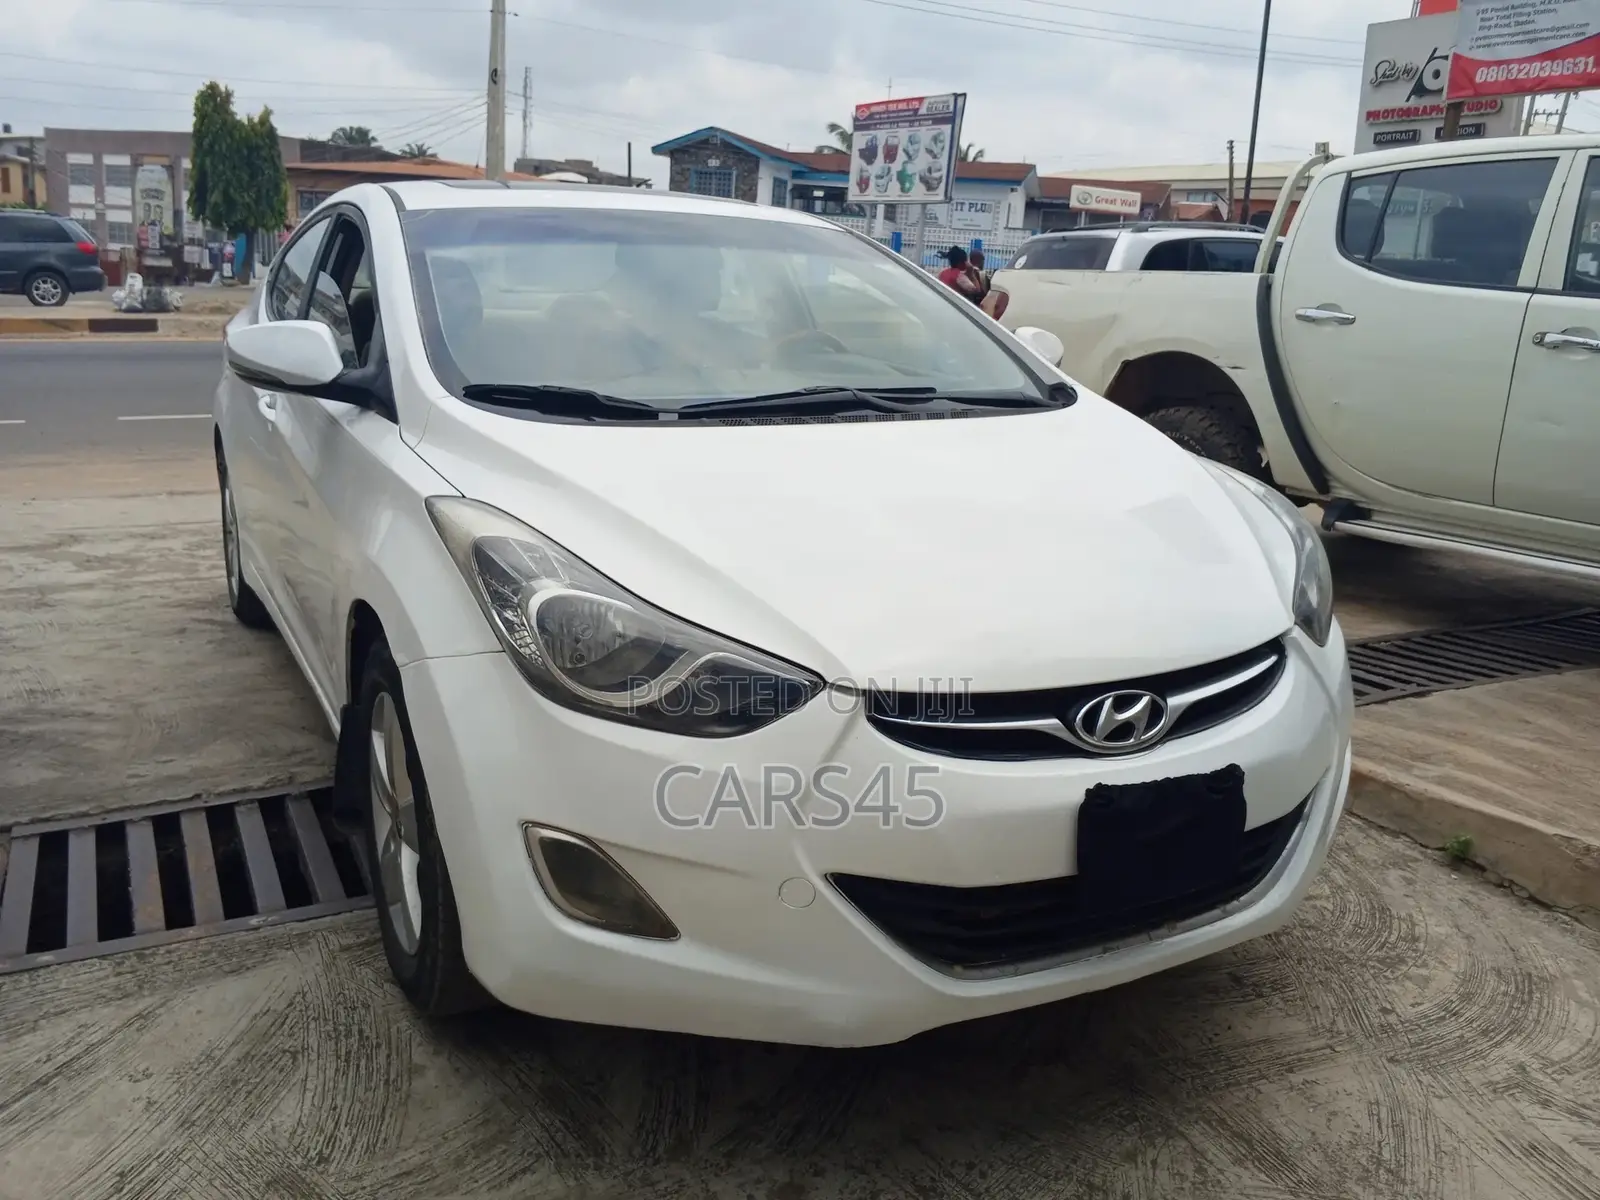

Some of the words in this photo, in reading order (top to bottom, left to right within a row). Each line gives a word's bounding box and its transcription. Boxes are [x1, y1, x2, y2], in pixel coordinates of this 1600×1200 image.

[1366, 103, 1446, 121] PHOTOGRAPH
[1376, 131, 1413, 142] PORTRAIT
[1095, 196, 1117, 206] Great
[1120, 198, 1137, 207] Wall
